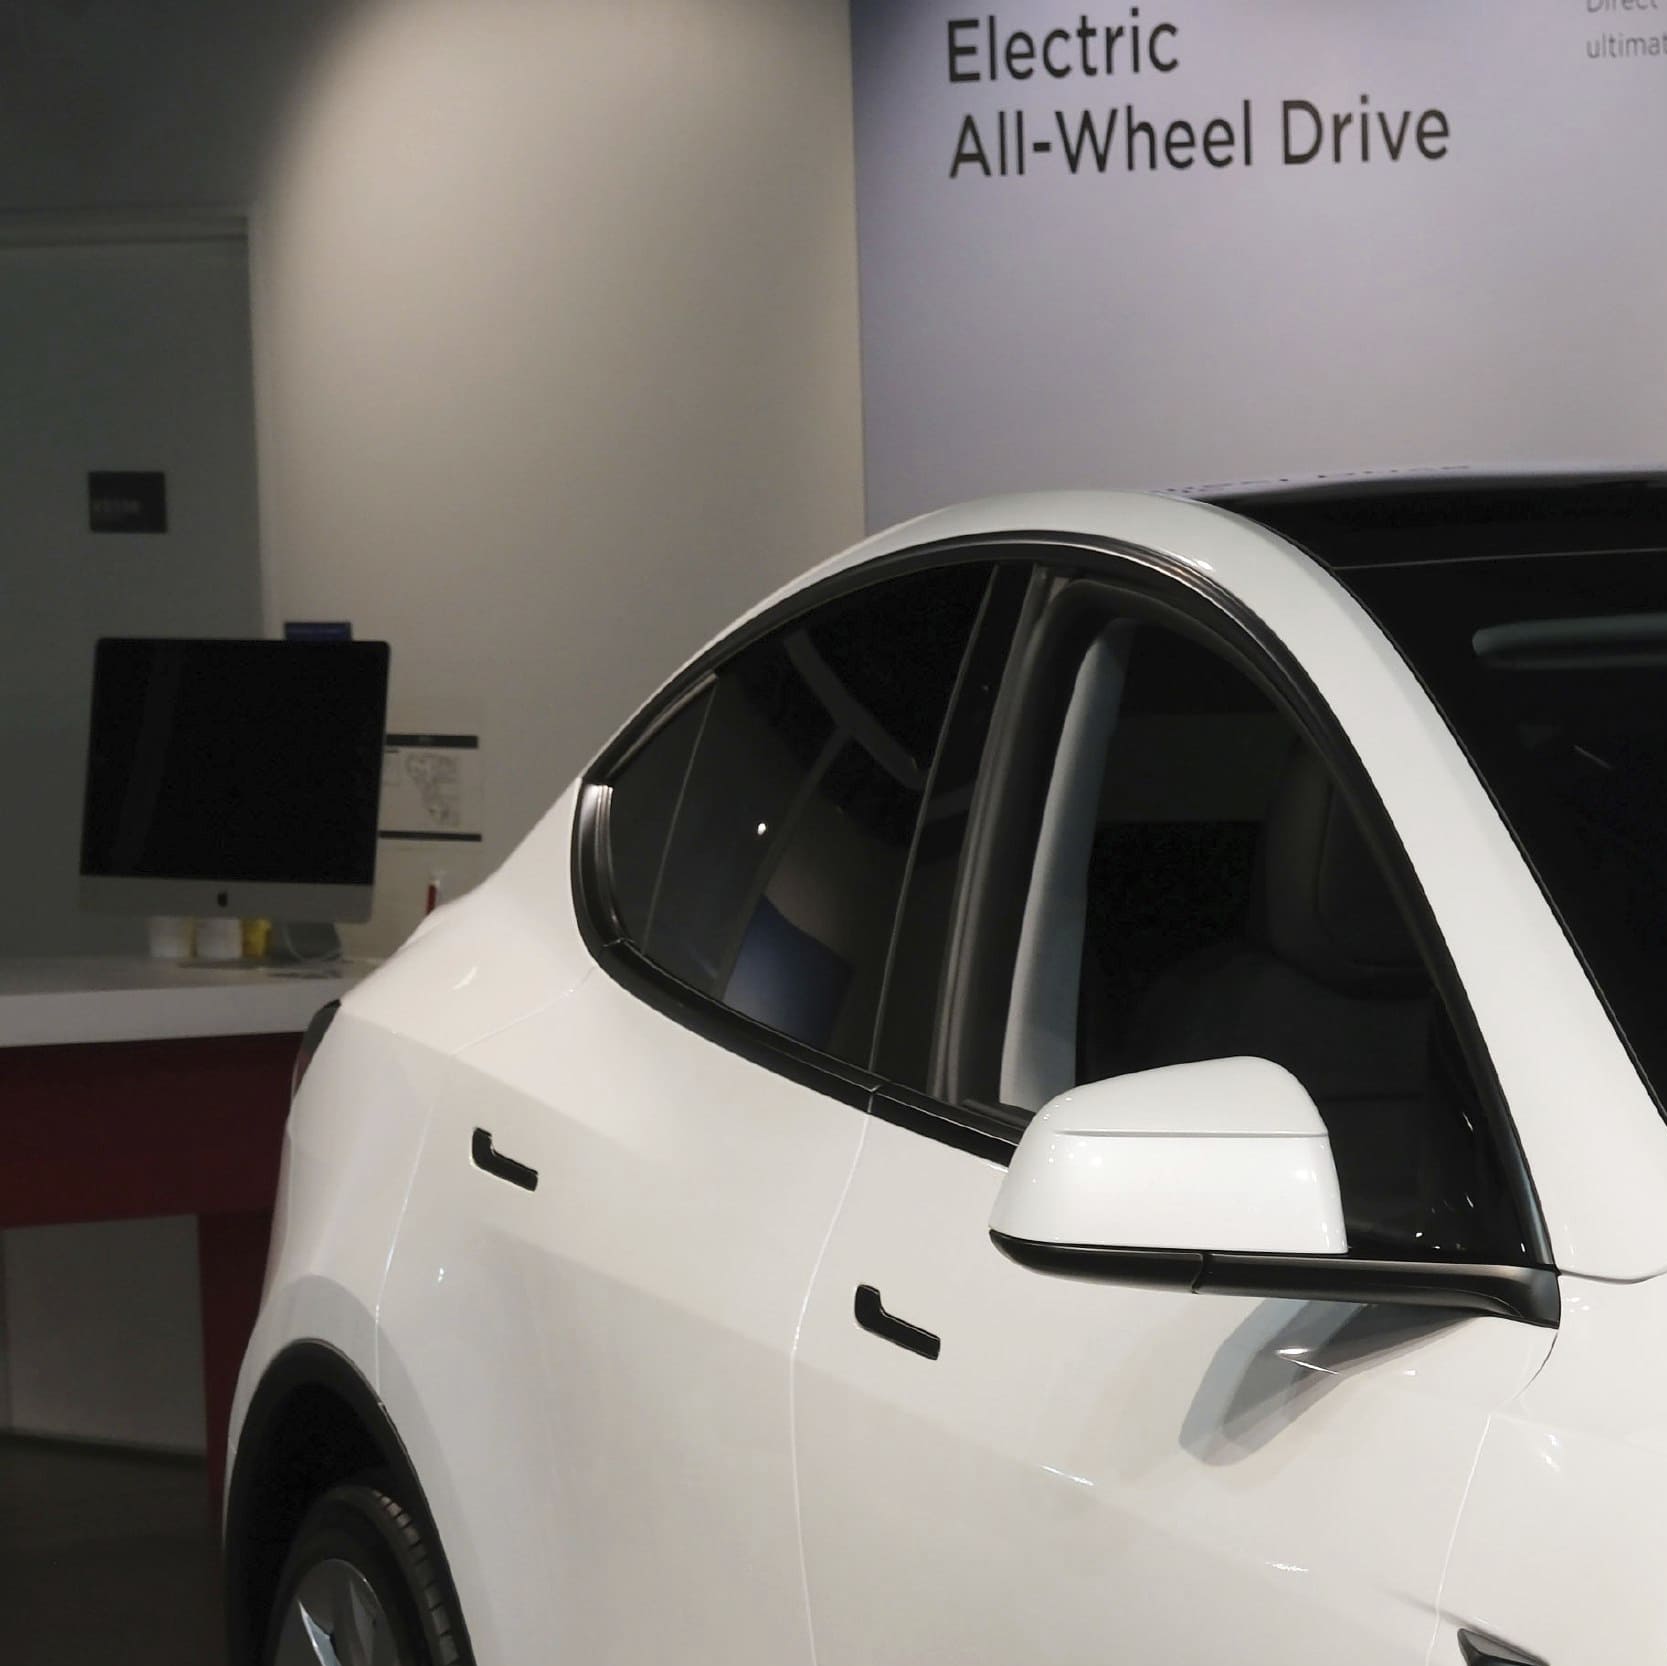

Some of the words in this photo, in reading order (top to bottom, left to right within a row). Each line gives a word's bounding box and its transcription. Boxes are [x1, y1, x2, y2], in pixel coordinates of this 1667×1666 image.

[947, 7, 1180, 84] Electric
[948, 99, 1253, 180] All-Wheel
[1281, 94, 1451, 166] Drive
